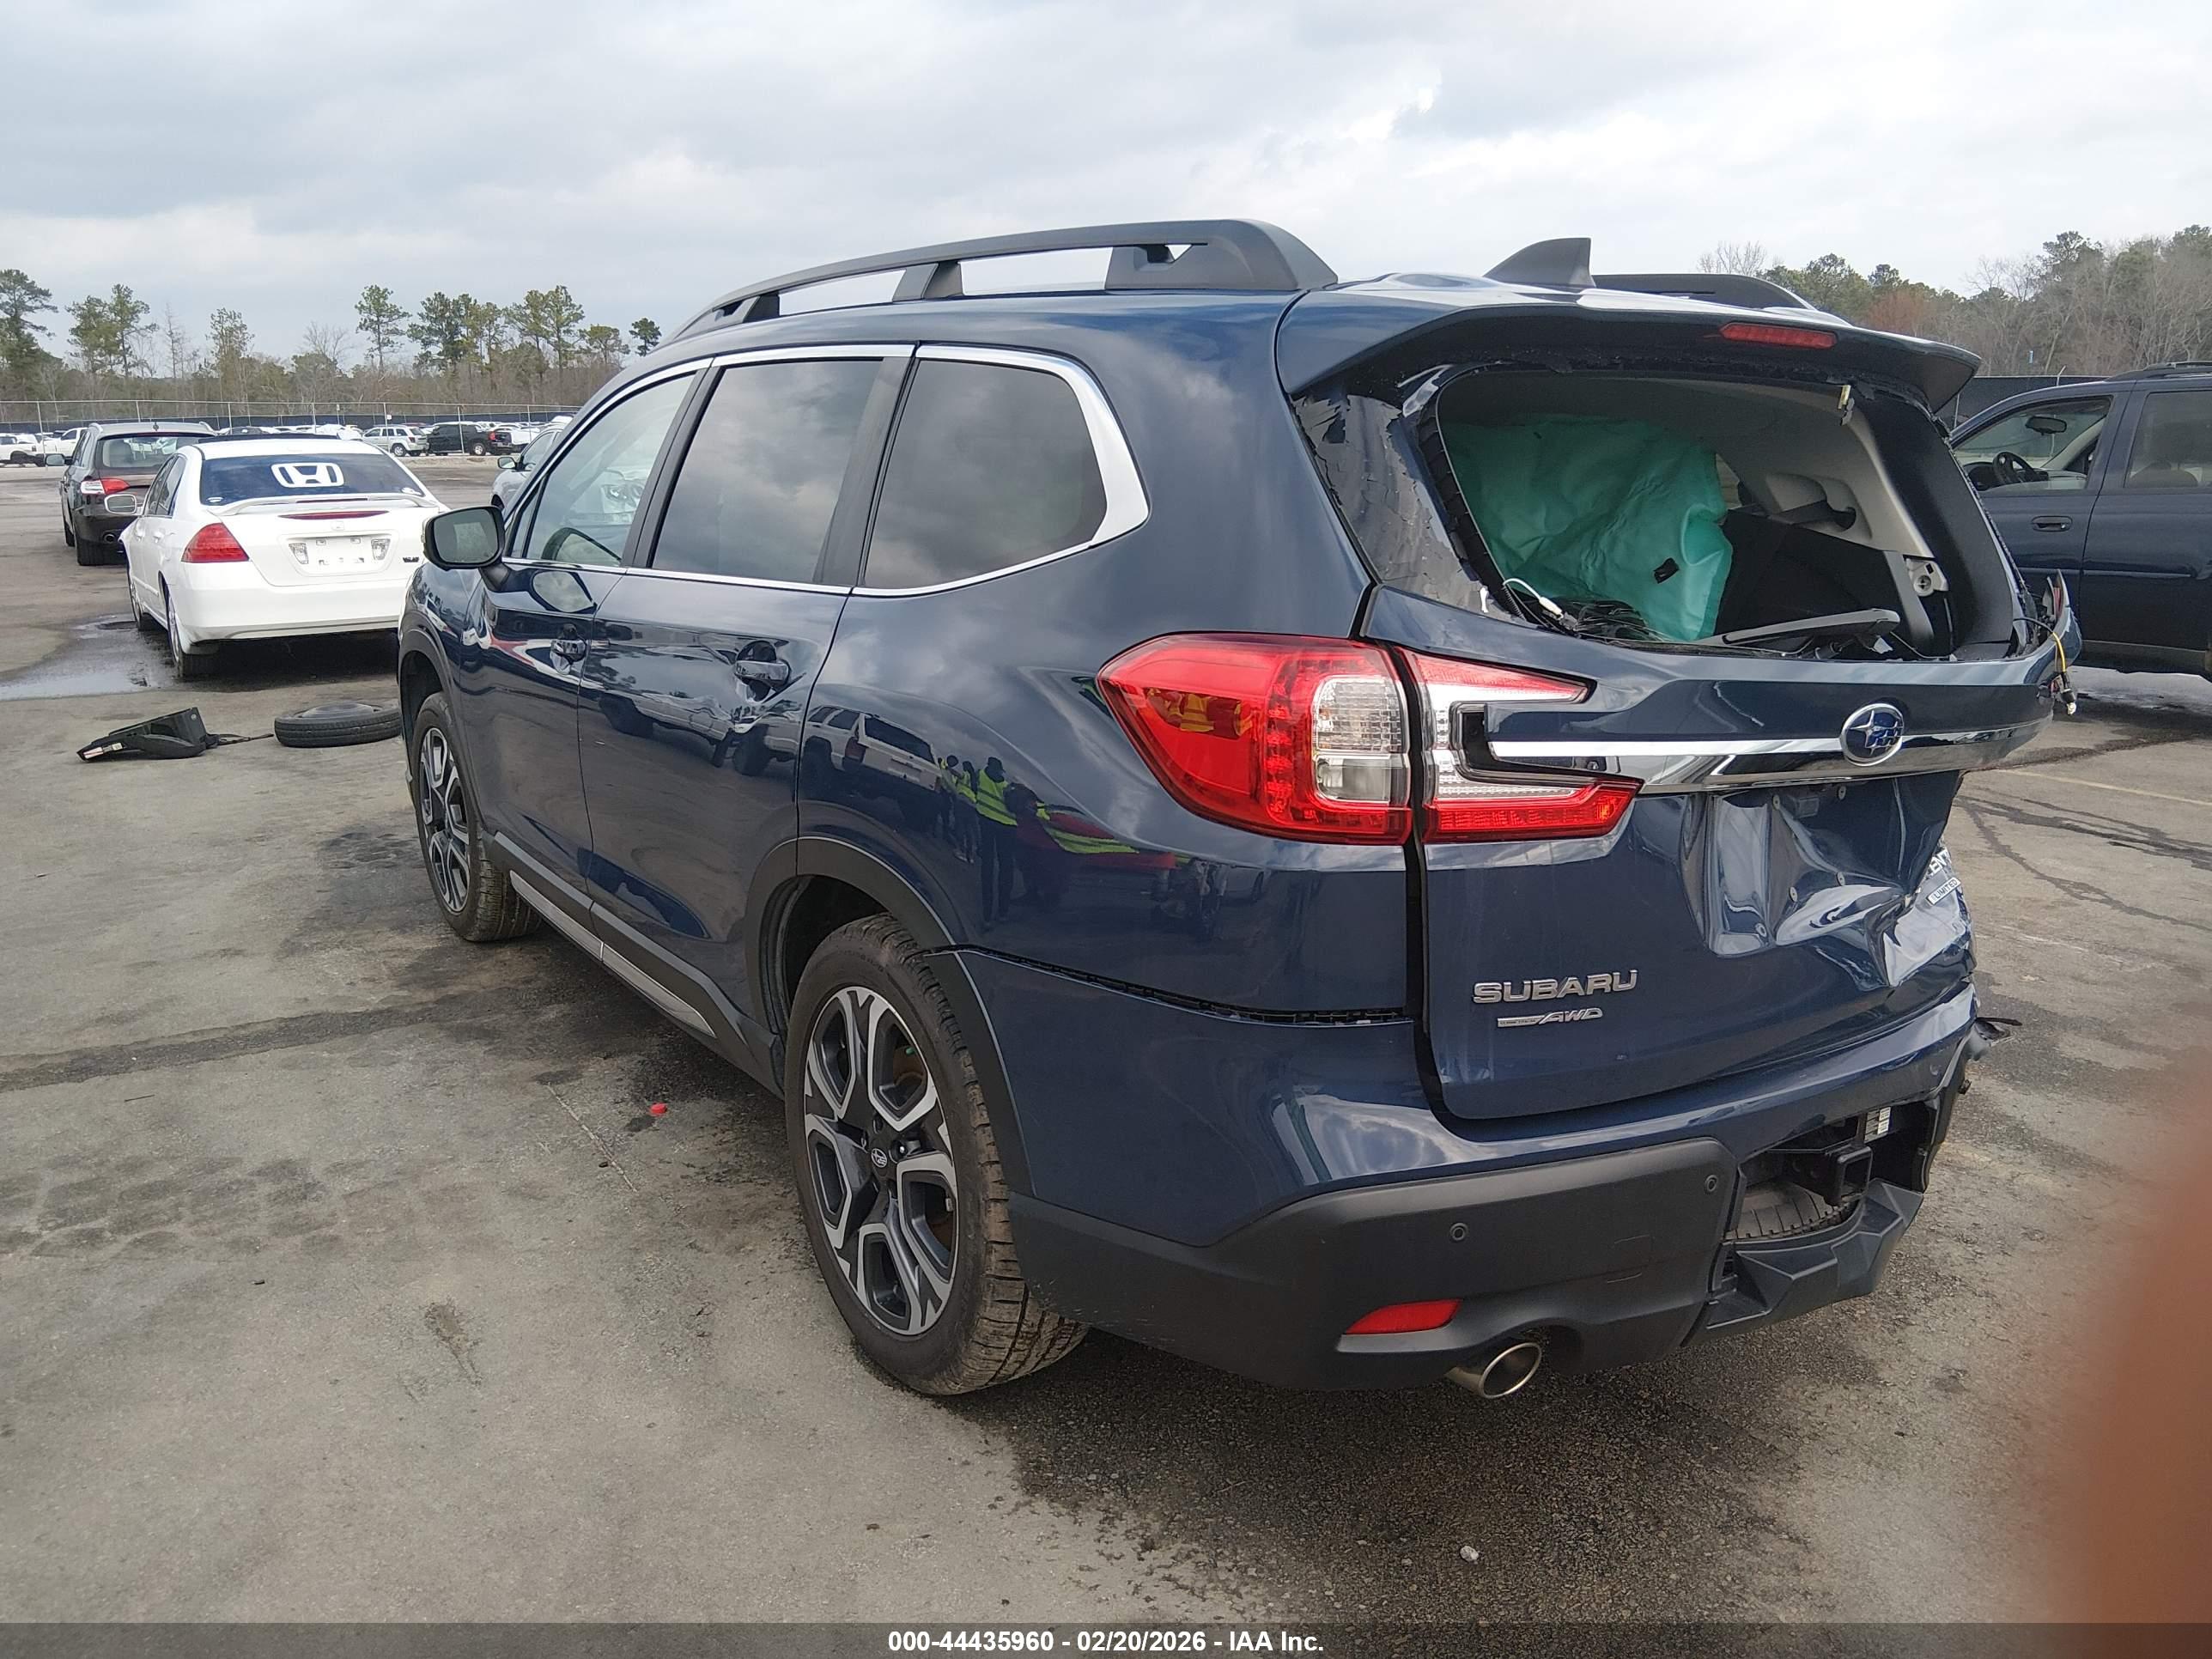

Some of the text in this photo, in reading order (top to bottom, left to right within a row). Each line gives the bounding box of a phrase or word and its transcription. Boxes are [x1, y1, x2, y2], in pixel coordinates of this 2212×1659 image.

[1933, 878, 1959, 900] LIMITED
[1473, 969, 1638, 1004] SUBARU
[1539, 1007, 1604, 1025] AWD
